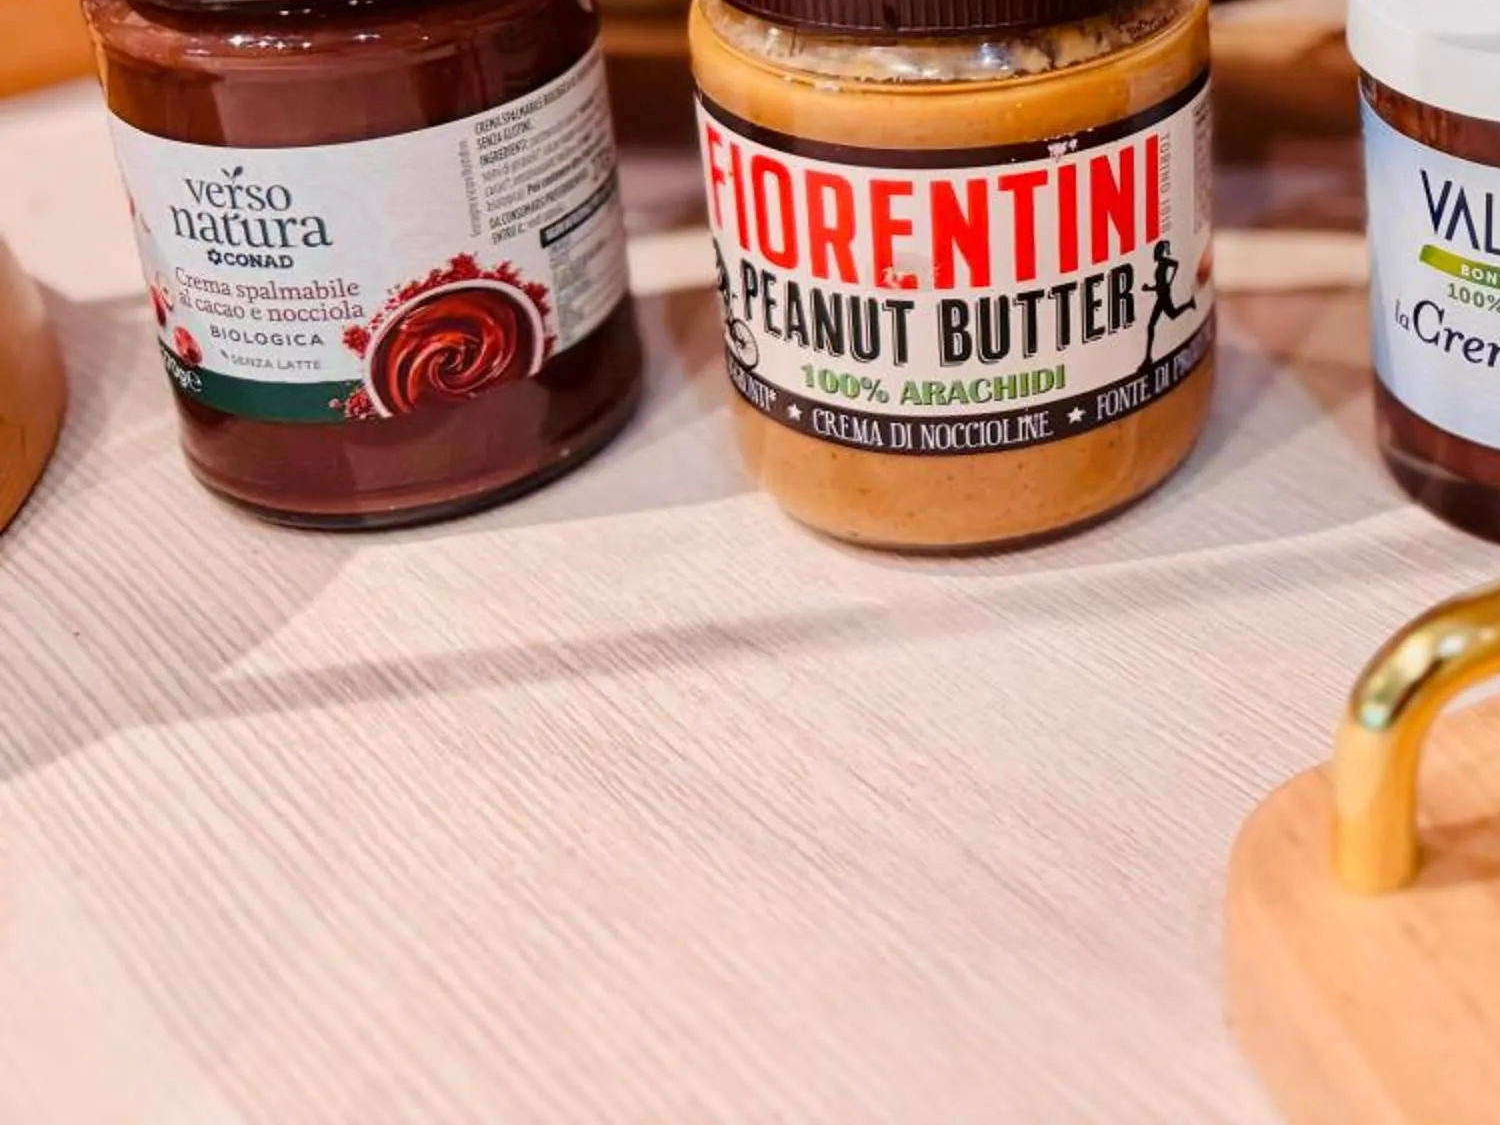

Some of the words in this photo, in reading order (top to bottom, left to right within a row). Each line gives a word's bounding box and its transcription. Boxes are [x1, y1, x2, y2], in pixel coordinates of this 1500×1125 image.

[184, 174, 292, 212] verso
[705, 121, 1160, 291] FIORENTINI
[171, 202, 334, 249] natura
[223, 251, 294, 270] CONAD
[175, 267, 231, 296] Crema
[236, 278, 360, 303] spalmabile
[178, 288, 193, 309] al
[194, 297, 245, 320] cacao
[250, 308, 262, 321] e
[267, 300, 365, 323] nocciola
[740, 259, 916, 366] PEANUT
[936, 262, 1137, 369] BUTTER
[1394, 298, 1410, 332] la
[210, 325, 325, 347] BIOLOGICA
[232, 353, 273, 370] SENZA
[276, 358, 321, 371] LATTE
[800, 363, 889, 404] 100%
[900, 363, 1067, 406] ARACHIDI
[1096, 373, 1152, 420] FONTE
[1154, 361, 1170, 394] DI
[812, 407, 884, 449] CREMA
[890, 423, 915, 449] DI
[920, 410, 1054, 452] NOCCIOLINE
